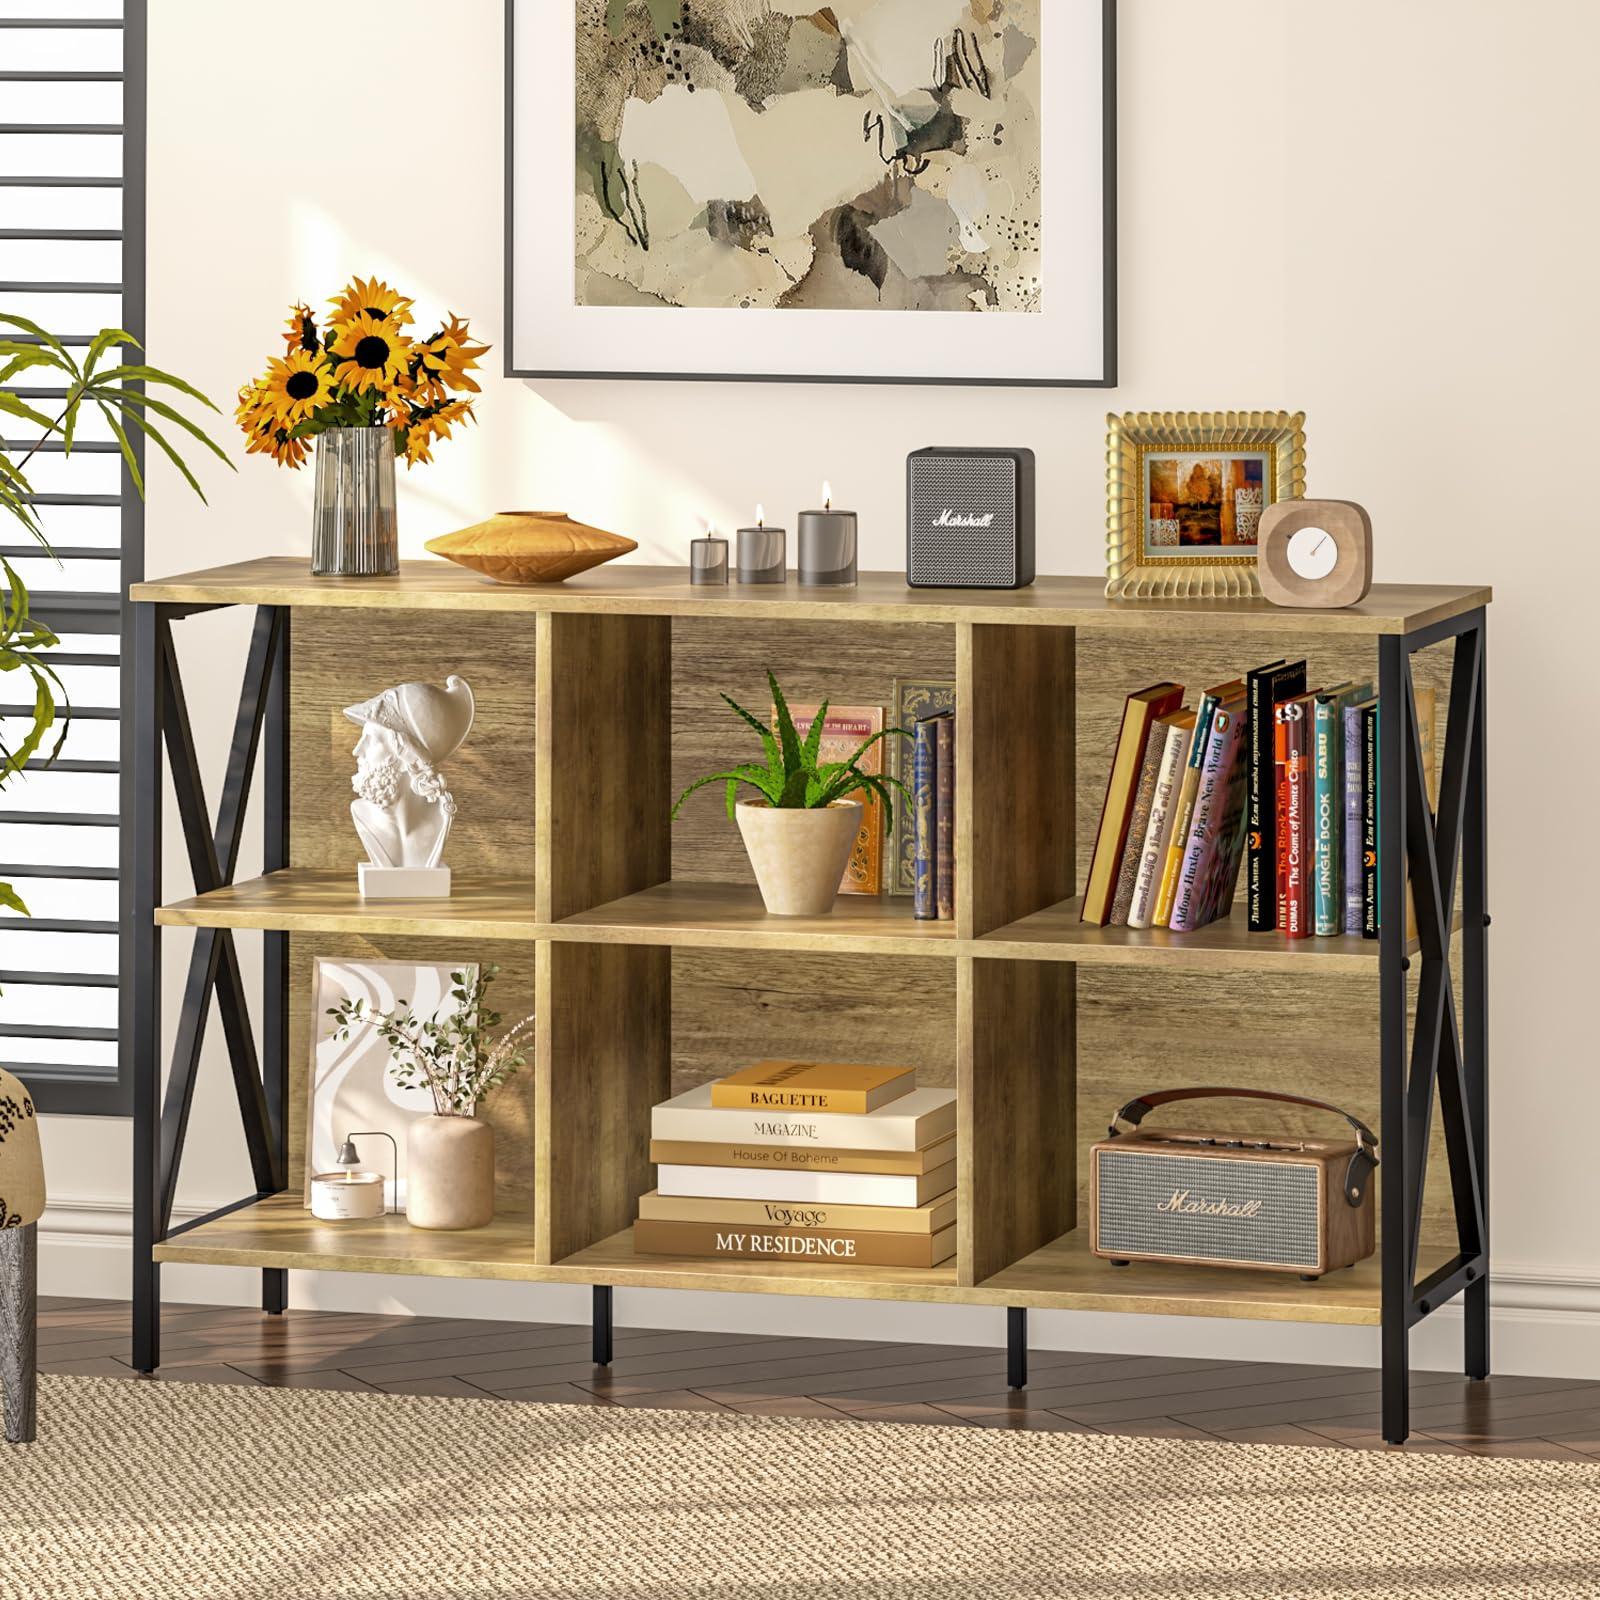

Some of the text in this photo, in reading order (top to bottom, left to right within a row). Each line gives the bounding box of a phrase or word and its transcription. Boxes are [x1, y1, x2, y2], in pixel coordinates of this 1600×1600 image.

[932, 509, 994, 527] Marshall
[1318, 733, 1327, 779] SABU
[1176, 738, 1223, 927] Aldous Huxley Brave New World
[1289, 750, 1300, 932] DUMAS The Count of Monte Cristo
[1320, 793, 1330, 897] JUNGLE BOOK
[751, 1092, 828, 1107] BAGUETTE
[755, 1122, 818, 1139] MAGAZINE
[733, 1150, 839, 1164] House Of Boheme
[1157, 1189, 1263, 1217] Marshall
[764, 1204, 827, 1227] Voyage
[716, 1233, 856, 1257] MY RESIDENCE
